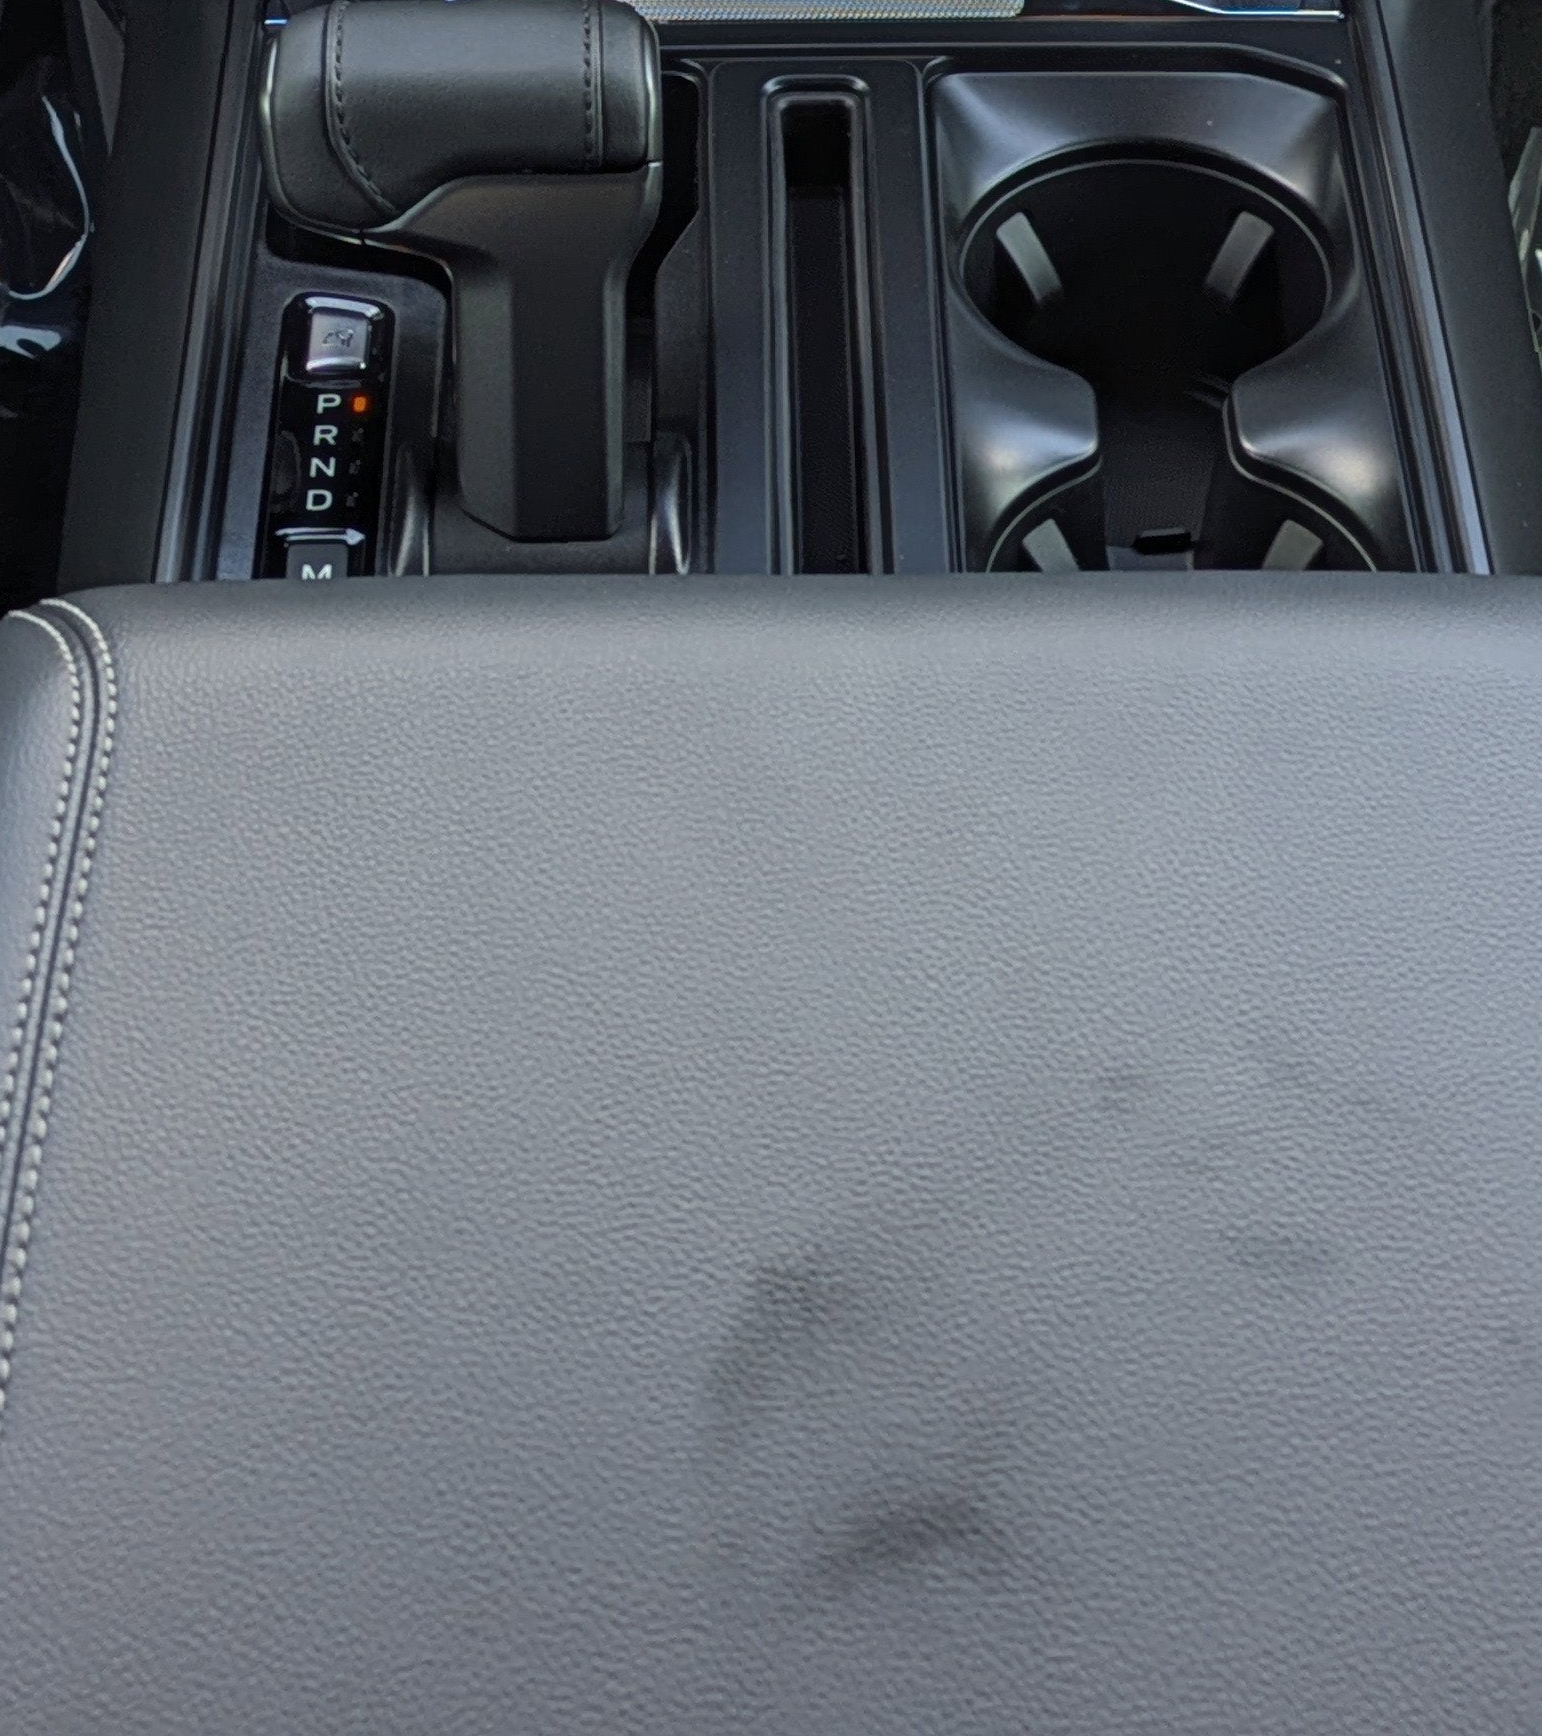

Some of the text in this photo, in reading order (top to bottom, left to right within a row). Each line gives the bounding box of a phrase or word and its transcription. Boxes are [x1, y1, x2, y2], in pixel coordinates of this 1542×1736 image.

[316, 394, 341, 414] P
[313, 425, 339, 446] R
[309, 457, 336, 478] N
[305, 489, 333, 511] D
[301, 564, 332, 580] M
